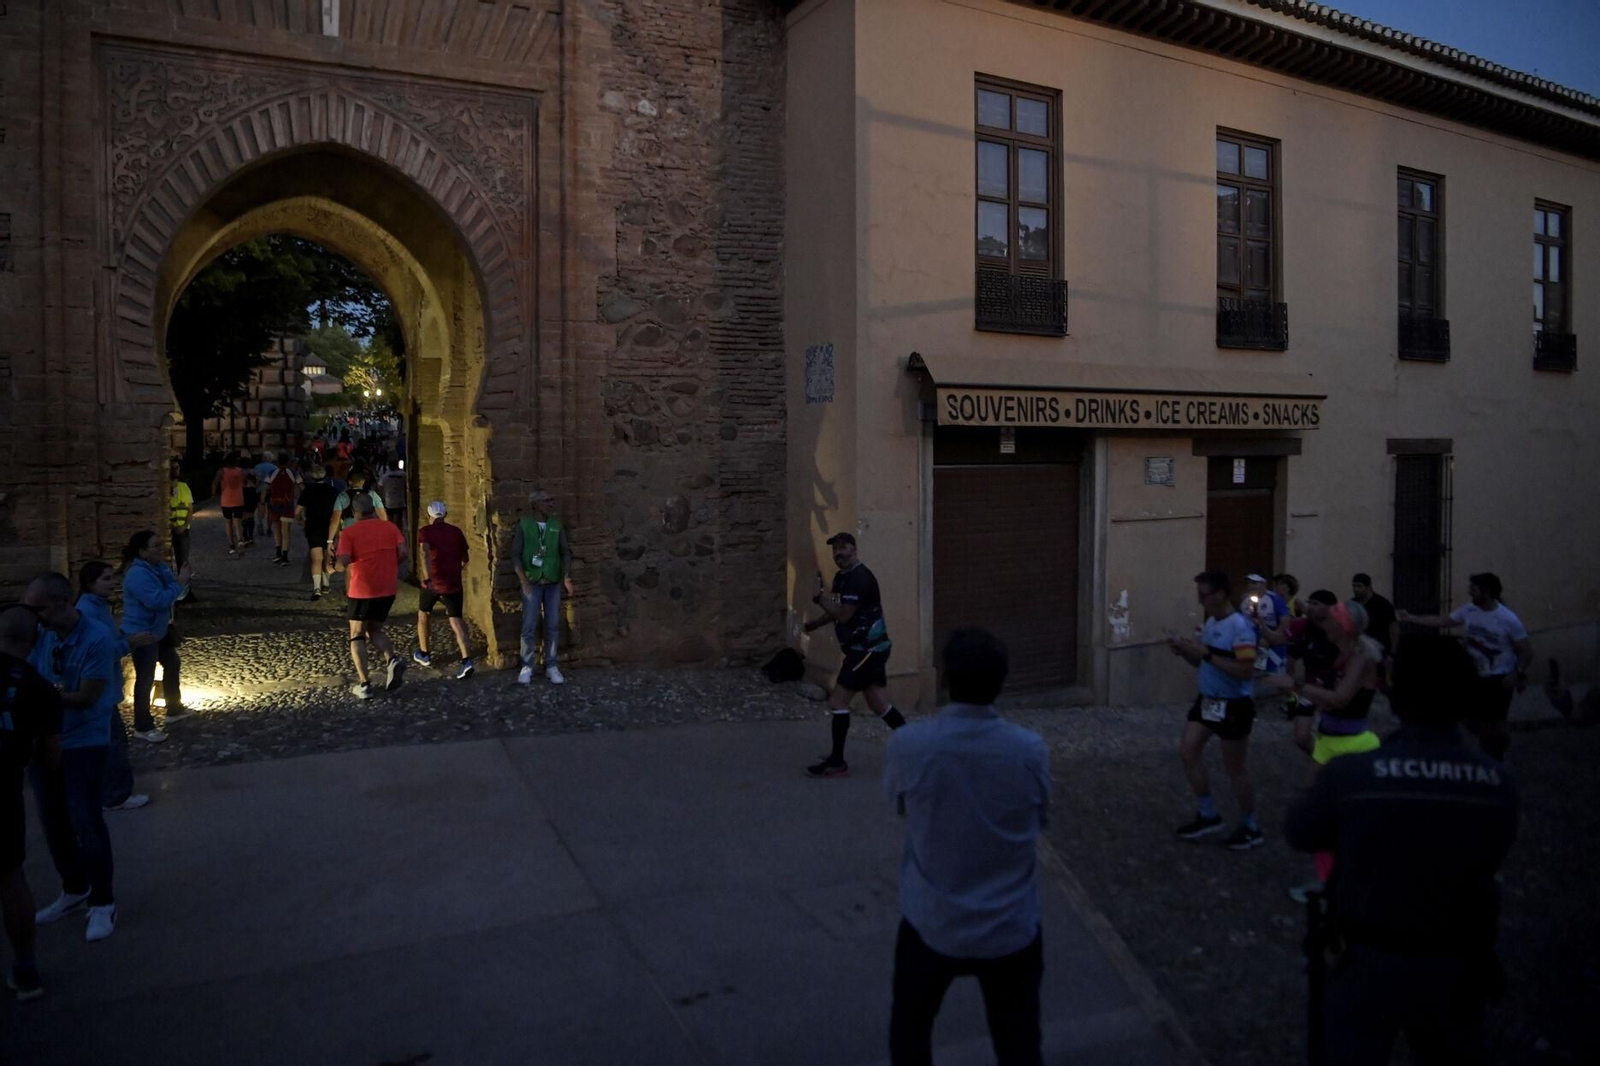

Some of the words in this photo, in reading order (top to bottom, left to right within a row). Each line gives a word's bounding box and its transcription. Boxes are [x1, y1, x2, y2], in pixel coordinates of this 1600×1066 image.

[947, 394, 1060, 423] SOUVENIRS
[1076, 398, 1139, 424] DRINKS
[1155, 400, 1181, 425] ICE
[1186, 401, 1249, 426] CREAMS
[1263, 404, 1320, 426] SNACKS
